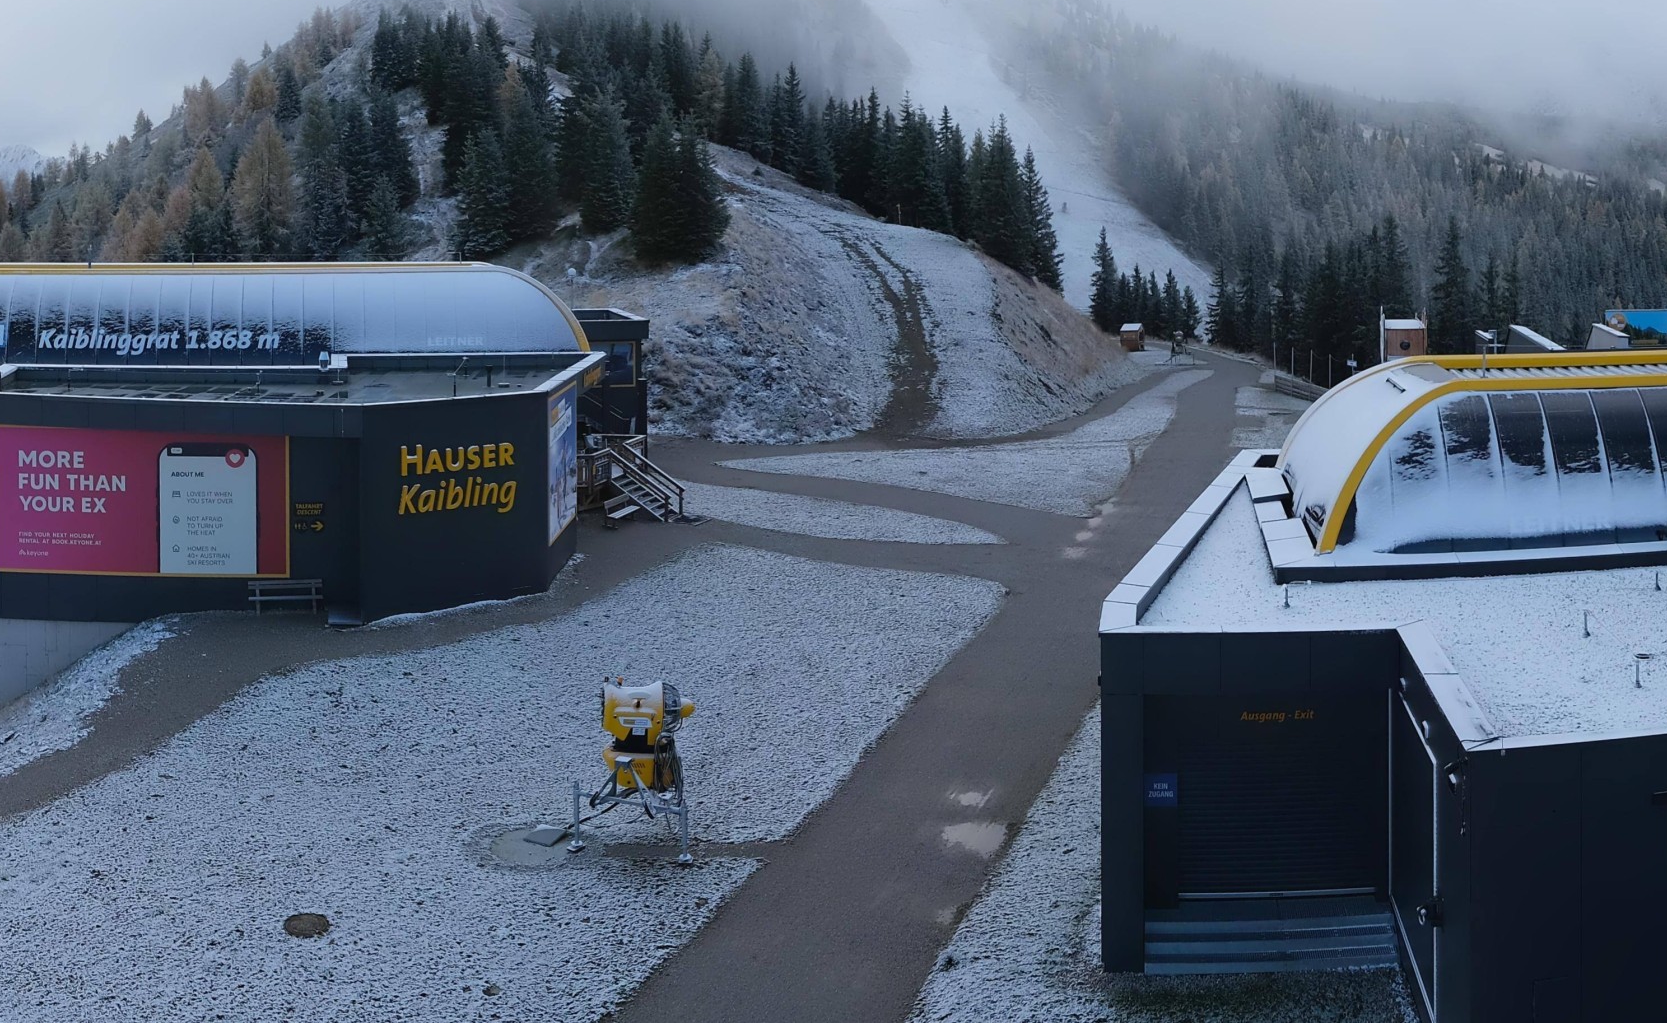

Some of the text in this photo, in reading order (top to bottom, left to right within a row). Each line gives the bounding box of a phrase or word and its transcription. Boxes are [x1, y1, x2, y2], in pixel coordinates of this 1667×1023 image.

[38, 329, 281, 356] Kaiblinggrat 1.868 m
[427, 337, 484, 346] LEITNER
[18, 450, 85, 469] MORE
[401, 442, 515, 476] HAUSER
[18, 473, 126, 492] FUN THAN
[19, 495, 107, 513] YOUR EX
[398, 477, 517, 515] Kaibling
[26, 549, 49, 557] keyone
[1240, 711, 1286, 723] Ausgang
[1294, 709, 1315, 720] Exit
